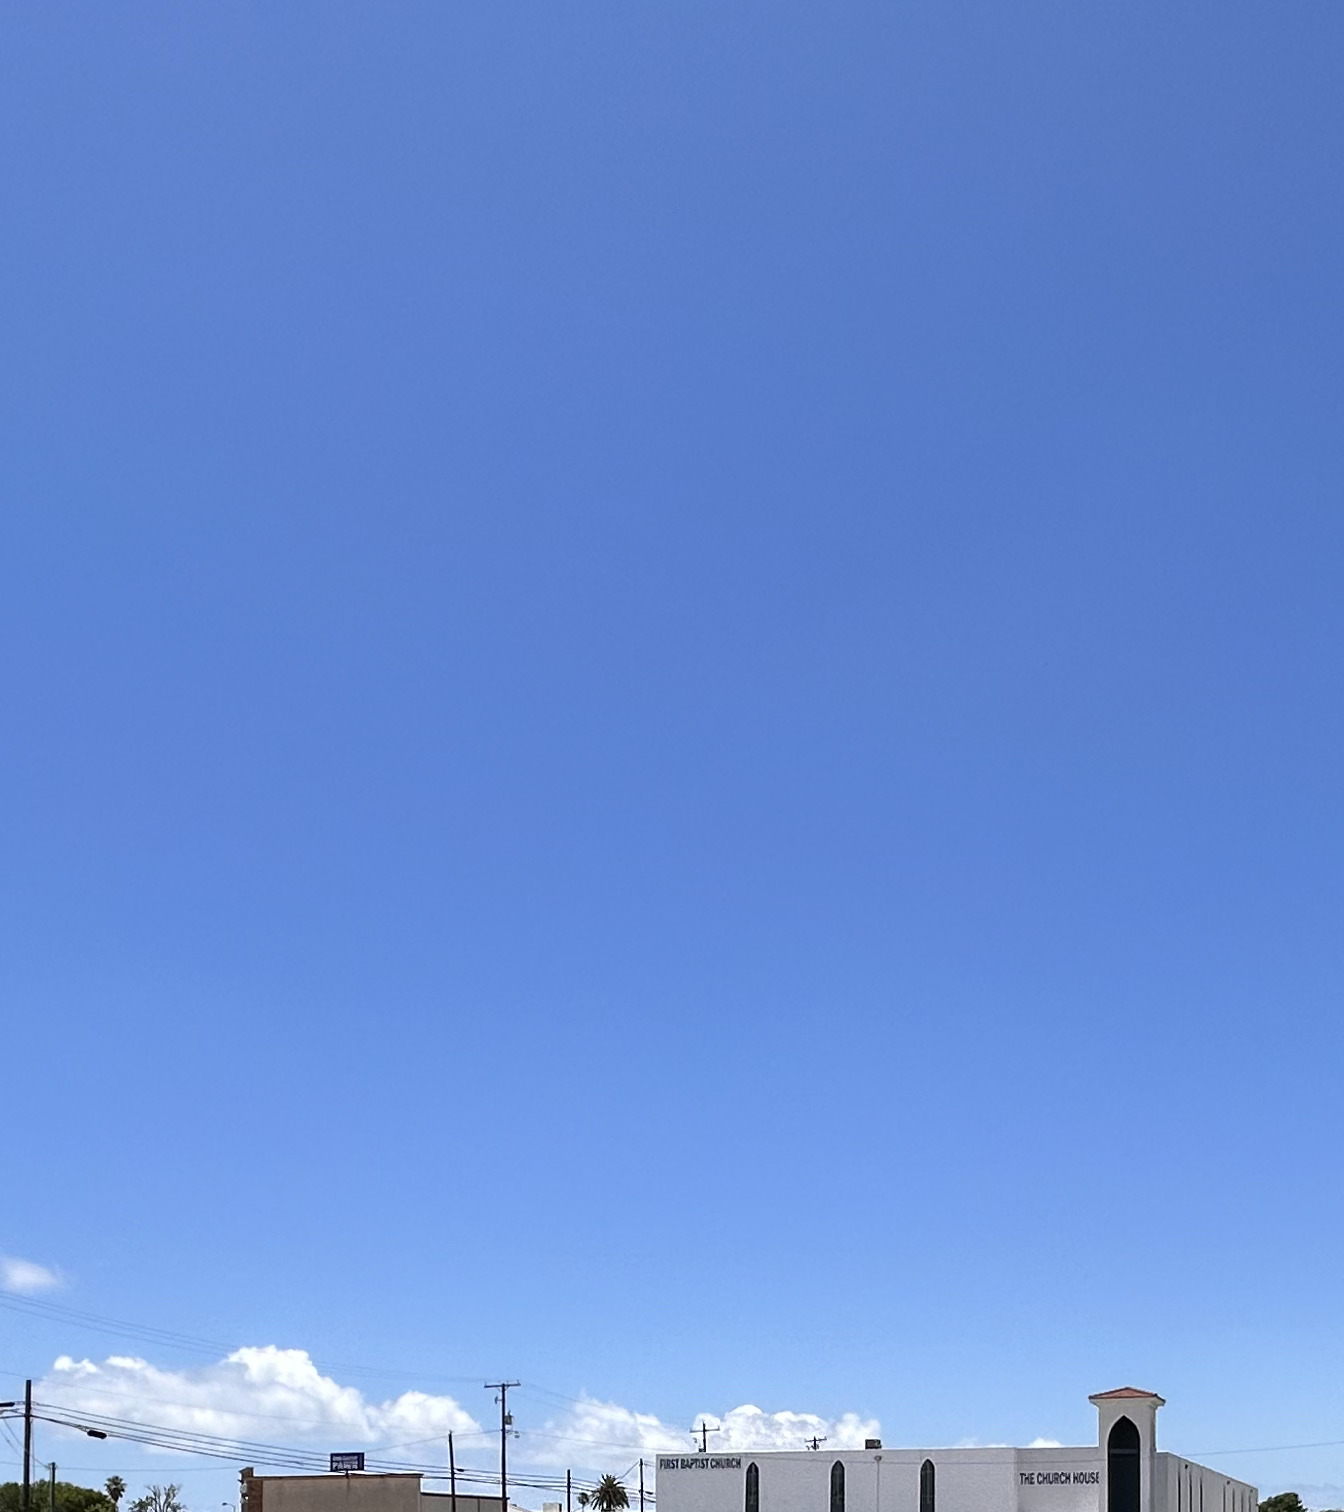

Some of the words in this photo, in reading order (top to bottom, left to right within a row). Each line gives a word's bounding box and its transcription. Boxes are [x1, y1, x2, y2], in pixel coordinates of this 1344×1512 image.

[659, 1458, 679, 1469] FIRST
[680, 1458, 709, 1469] BAPTIST
[710, 1457, 741, 1469] CHURCH
[1019, 1472, 1035, 1485] THE
[1036, 1471, 1071, 1485] CHURCH
[1072, 1471, 1100, 1484] HOUSE
